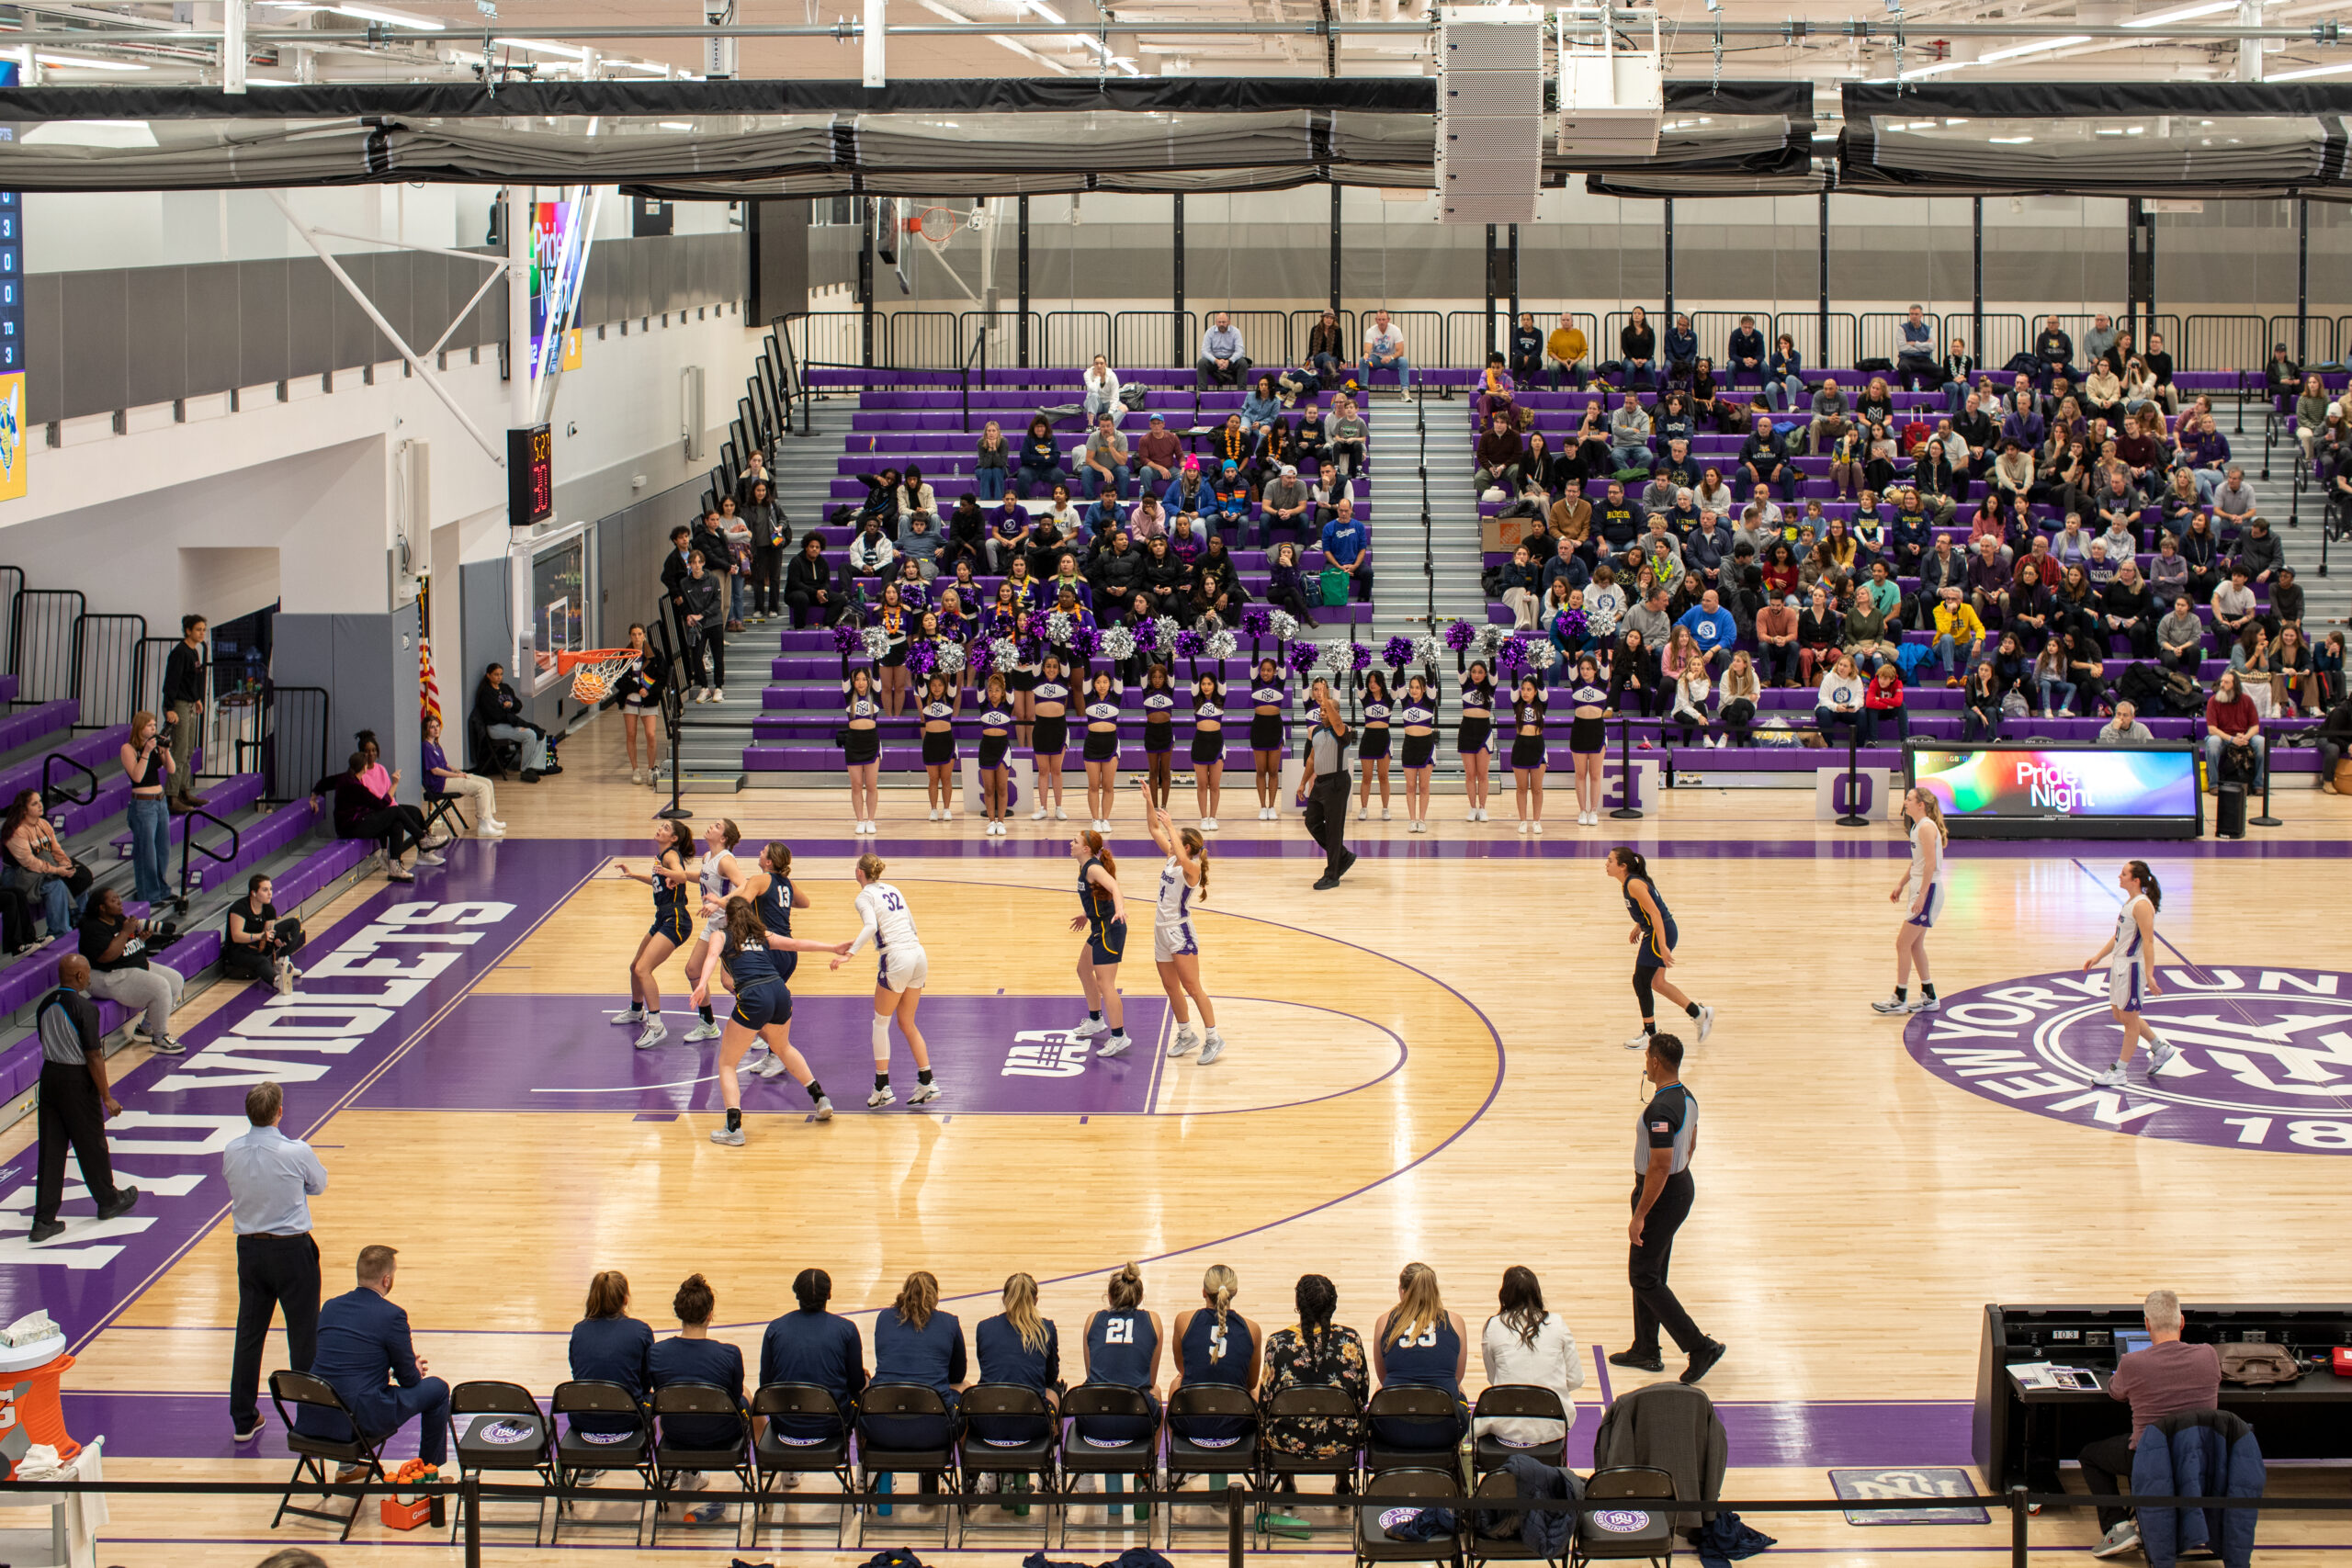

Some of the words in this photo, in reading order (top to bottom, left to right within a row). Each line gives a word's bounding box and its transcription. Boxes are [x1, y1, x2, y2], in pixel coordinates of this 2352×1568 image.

[3, 219, 11, 237] 3
[4, 254, 12, 271] 0
[5, 285, 12, 303] 0
[5, 346, 13, 364] 3
[570, 336, 575, 356] 3
[2017, 761, 2078, 785] Pride
[2030, 783, 2095, 812] Night
[777, 885, 790, 908] 13
[883, 892, 904, 912] 32
[148, 901, 517, 1091] VIOLETS
[1927, 972, 2111, 1041] YORK
[1928, 1047, 2171, 1125] NEW
[1105, 1318, 1134, 1344] 21
[1209, 1325, 1228, 1358] 5
